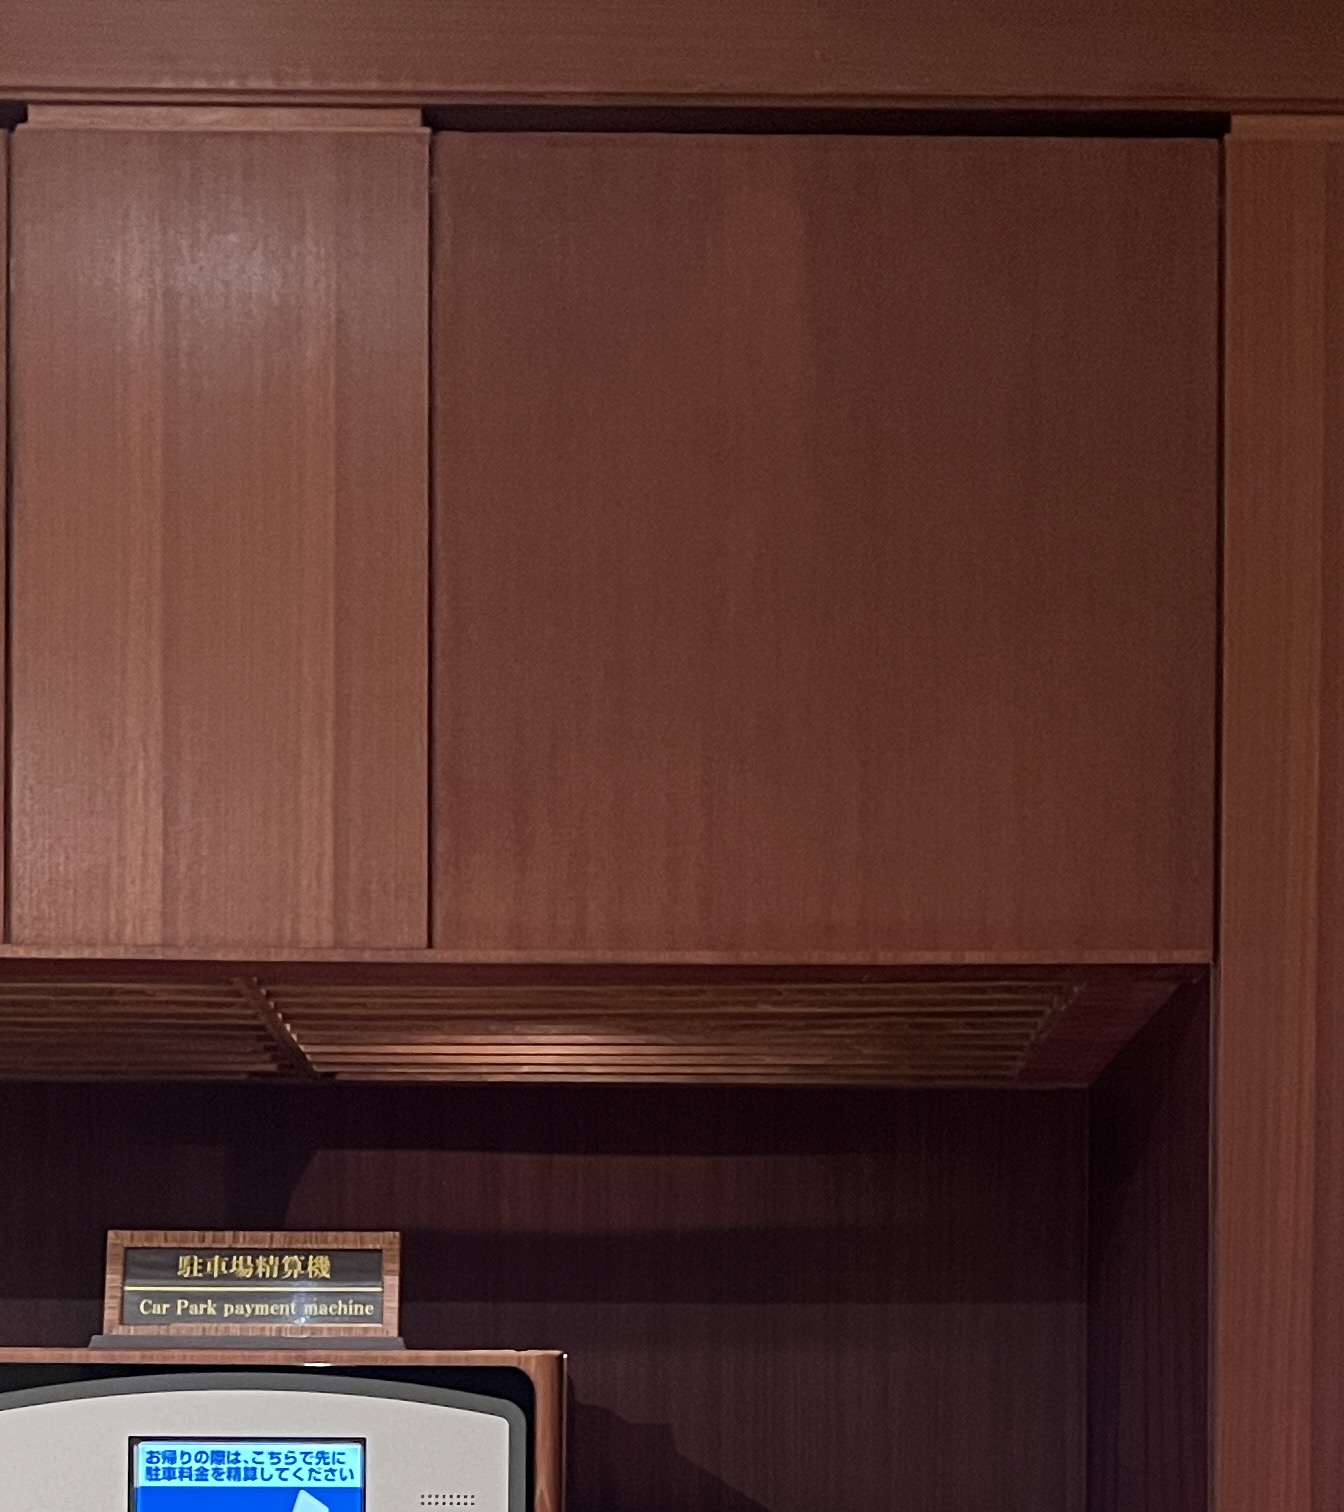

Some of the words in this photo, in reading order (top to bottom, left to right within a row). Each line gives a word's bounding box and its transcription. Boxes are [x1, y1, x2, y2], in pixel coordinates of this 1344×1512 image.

[177, 1254, 332, 1280] 駐車場精算機
[139, 1298, 171, 1316] Car
[176, 1298, 217, 1316] Park
[223, 1301, 297, 1319] payment
[304, 1298, 374, 1316] machine
[145, 1450, 347, 1466] お帰りの際は、こちらで先に
[145, 1466, 355, 1482] 駐車料金を精算してください
